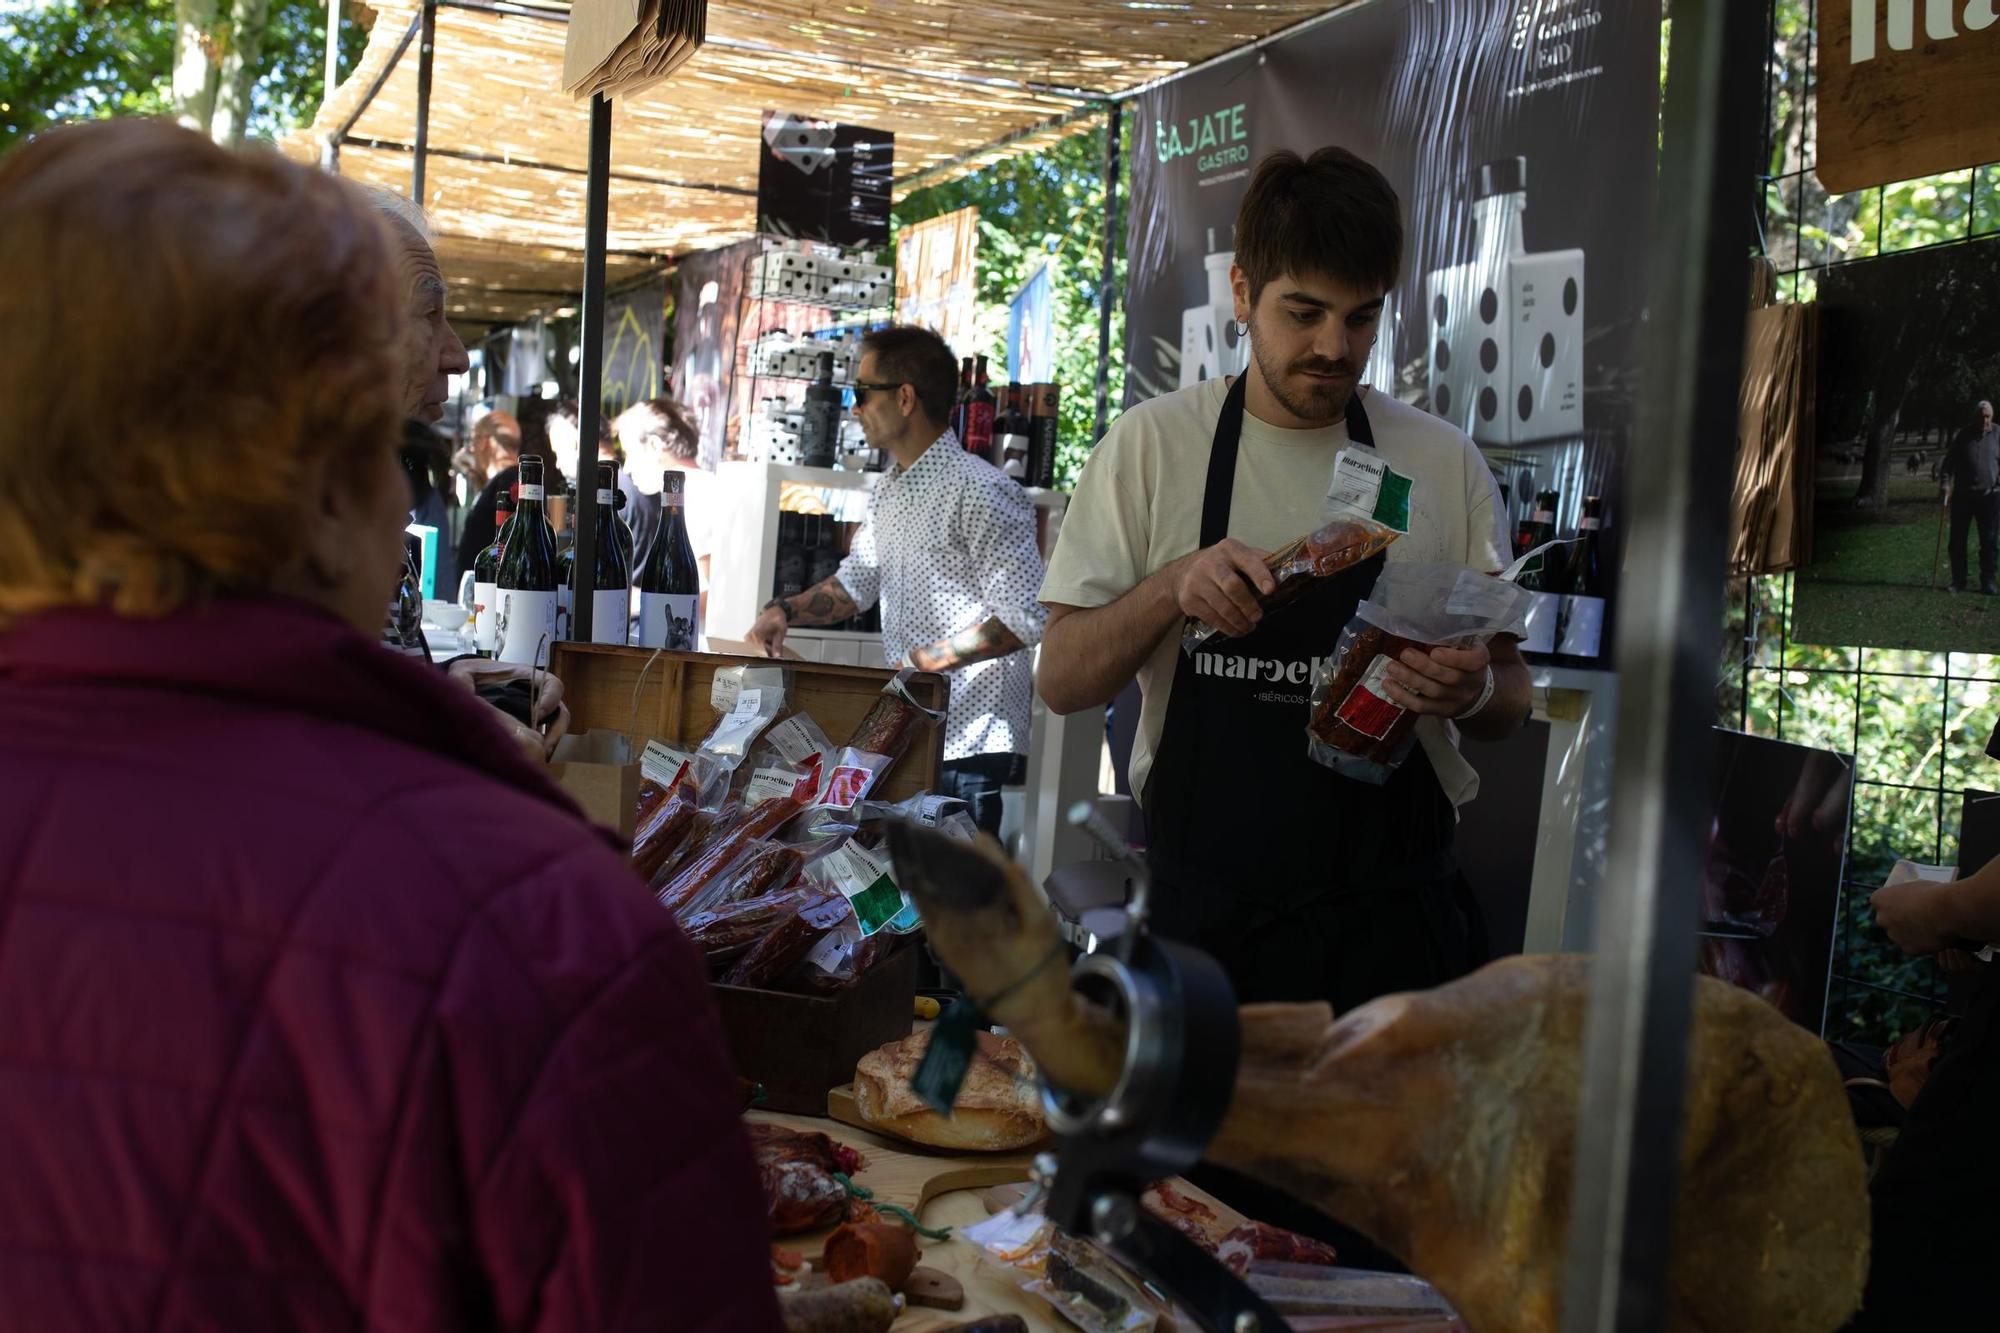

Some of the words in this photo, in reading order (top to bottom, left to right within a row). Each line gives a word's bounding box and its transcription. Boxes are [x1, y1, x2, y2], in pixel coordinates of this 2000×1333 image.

[1197, 144, 1249, 172] GASTRO
[646, 745, 681, 768] marcelino
[753, 773, 794, 787] marcelino
[845, 842, 881, 877] marcelino
